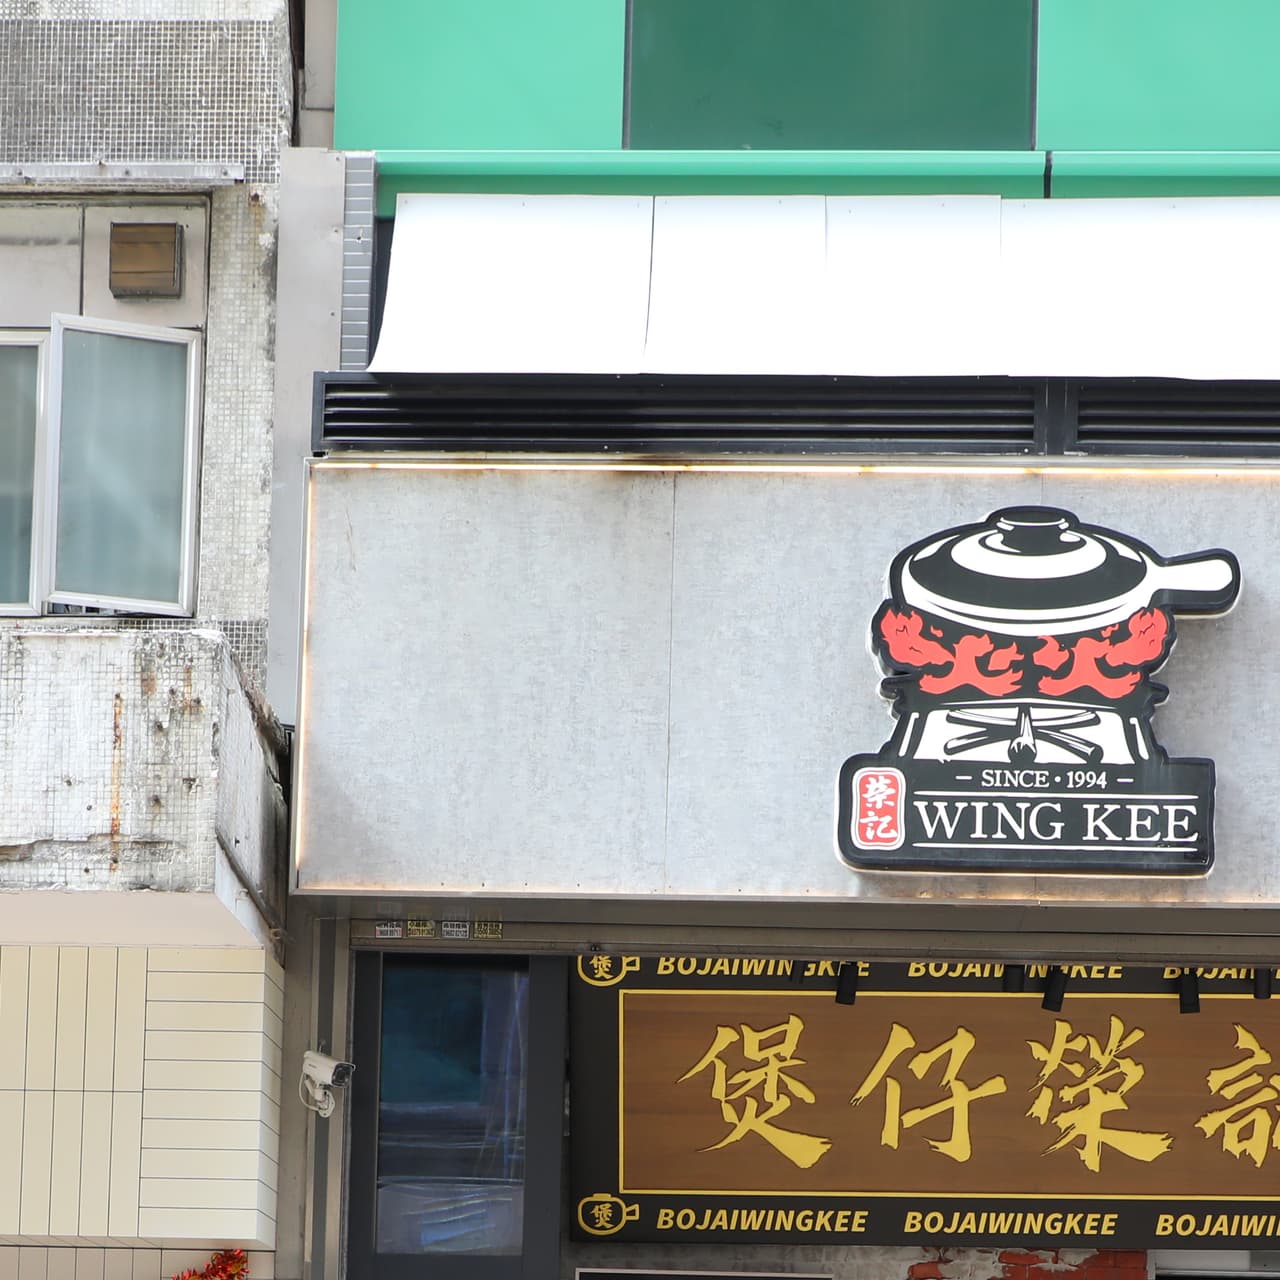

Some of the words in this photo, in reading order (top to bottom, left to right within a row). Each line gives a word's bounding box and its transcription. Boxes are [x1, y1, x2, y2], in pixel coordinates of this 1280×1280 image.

[981, 770, 1050, 789] SINCE
[1066, 770, 1108, 789] 1994
[913, 803, 1063, 842] WING
[1082, 805, 1199, 843] KEE
[657, 957, 871, 977] BOJAIWINKE
[656, 1208, 868, 1234] BOJAIWINGKEE
[903, 1211, 1118, 1236] BOJAIWINGKEE
